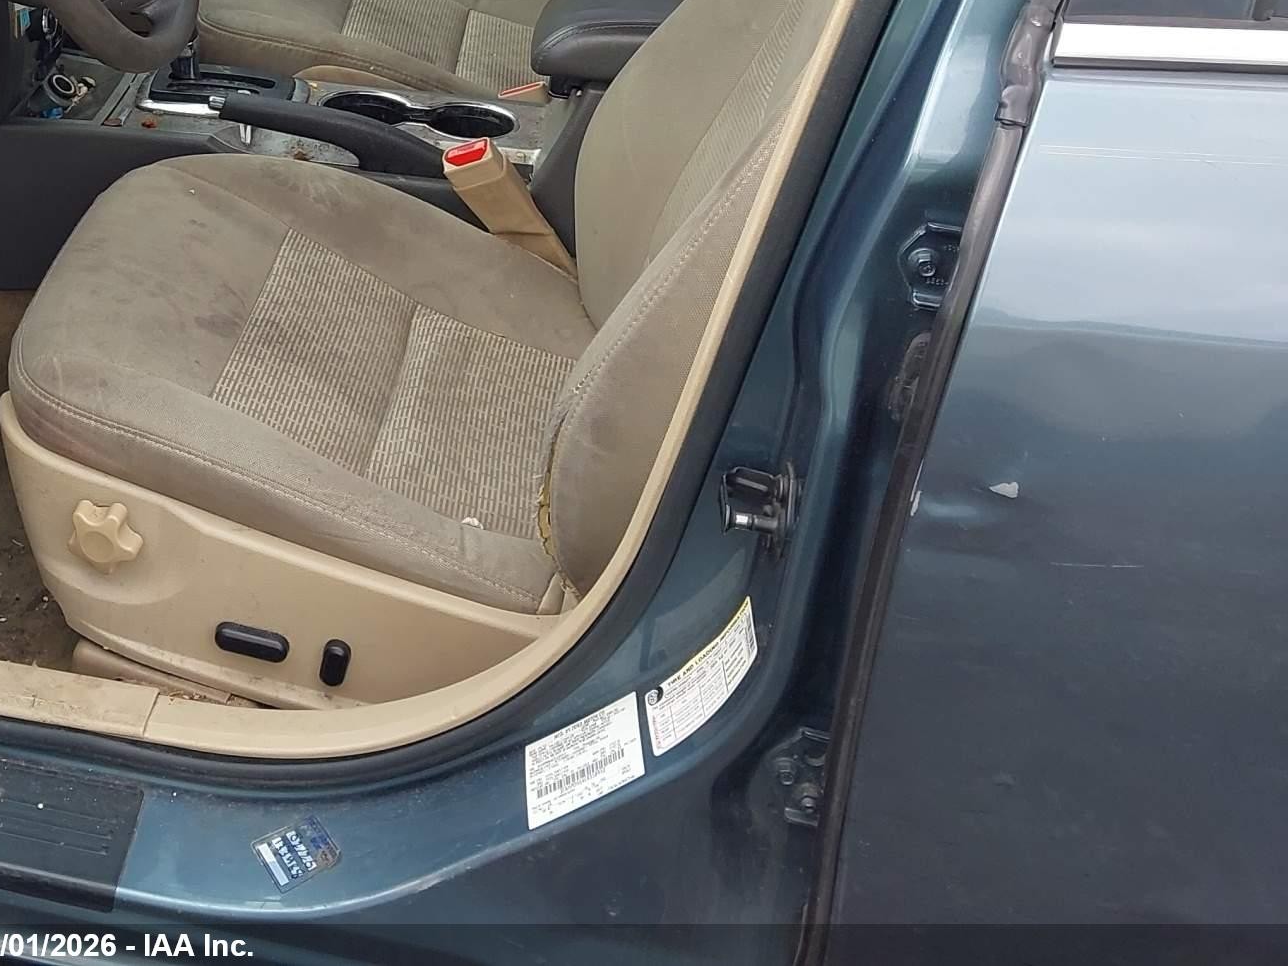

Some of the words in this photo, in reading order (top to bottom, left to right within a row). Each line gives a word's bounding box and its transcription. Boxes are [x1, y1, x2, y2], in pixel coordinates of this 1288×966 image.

[667, 675, 681, 687] TIRE
[683, 664, 694, 677] AND
[695, 641, 720, 665] LOADING
